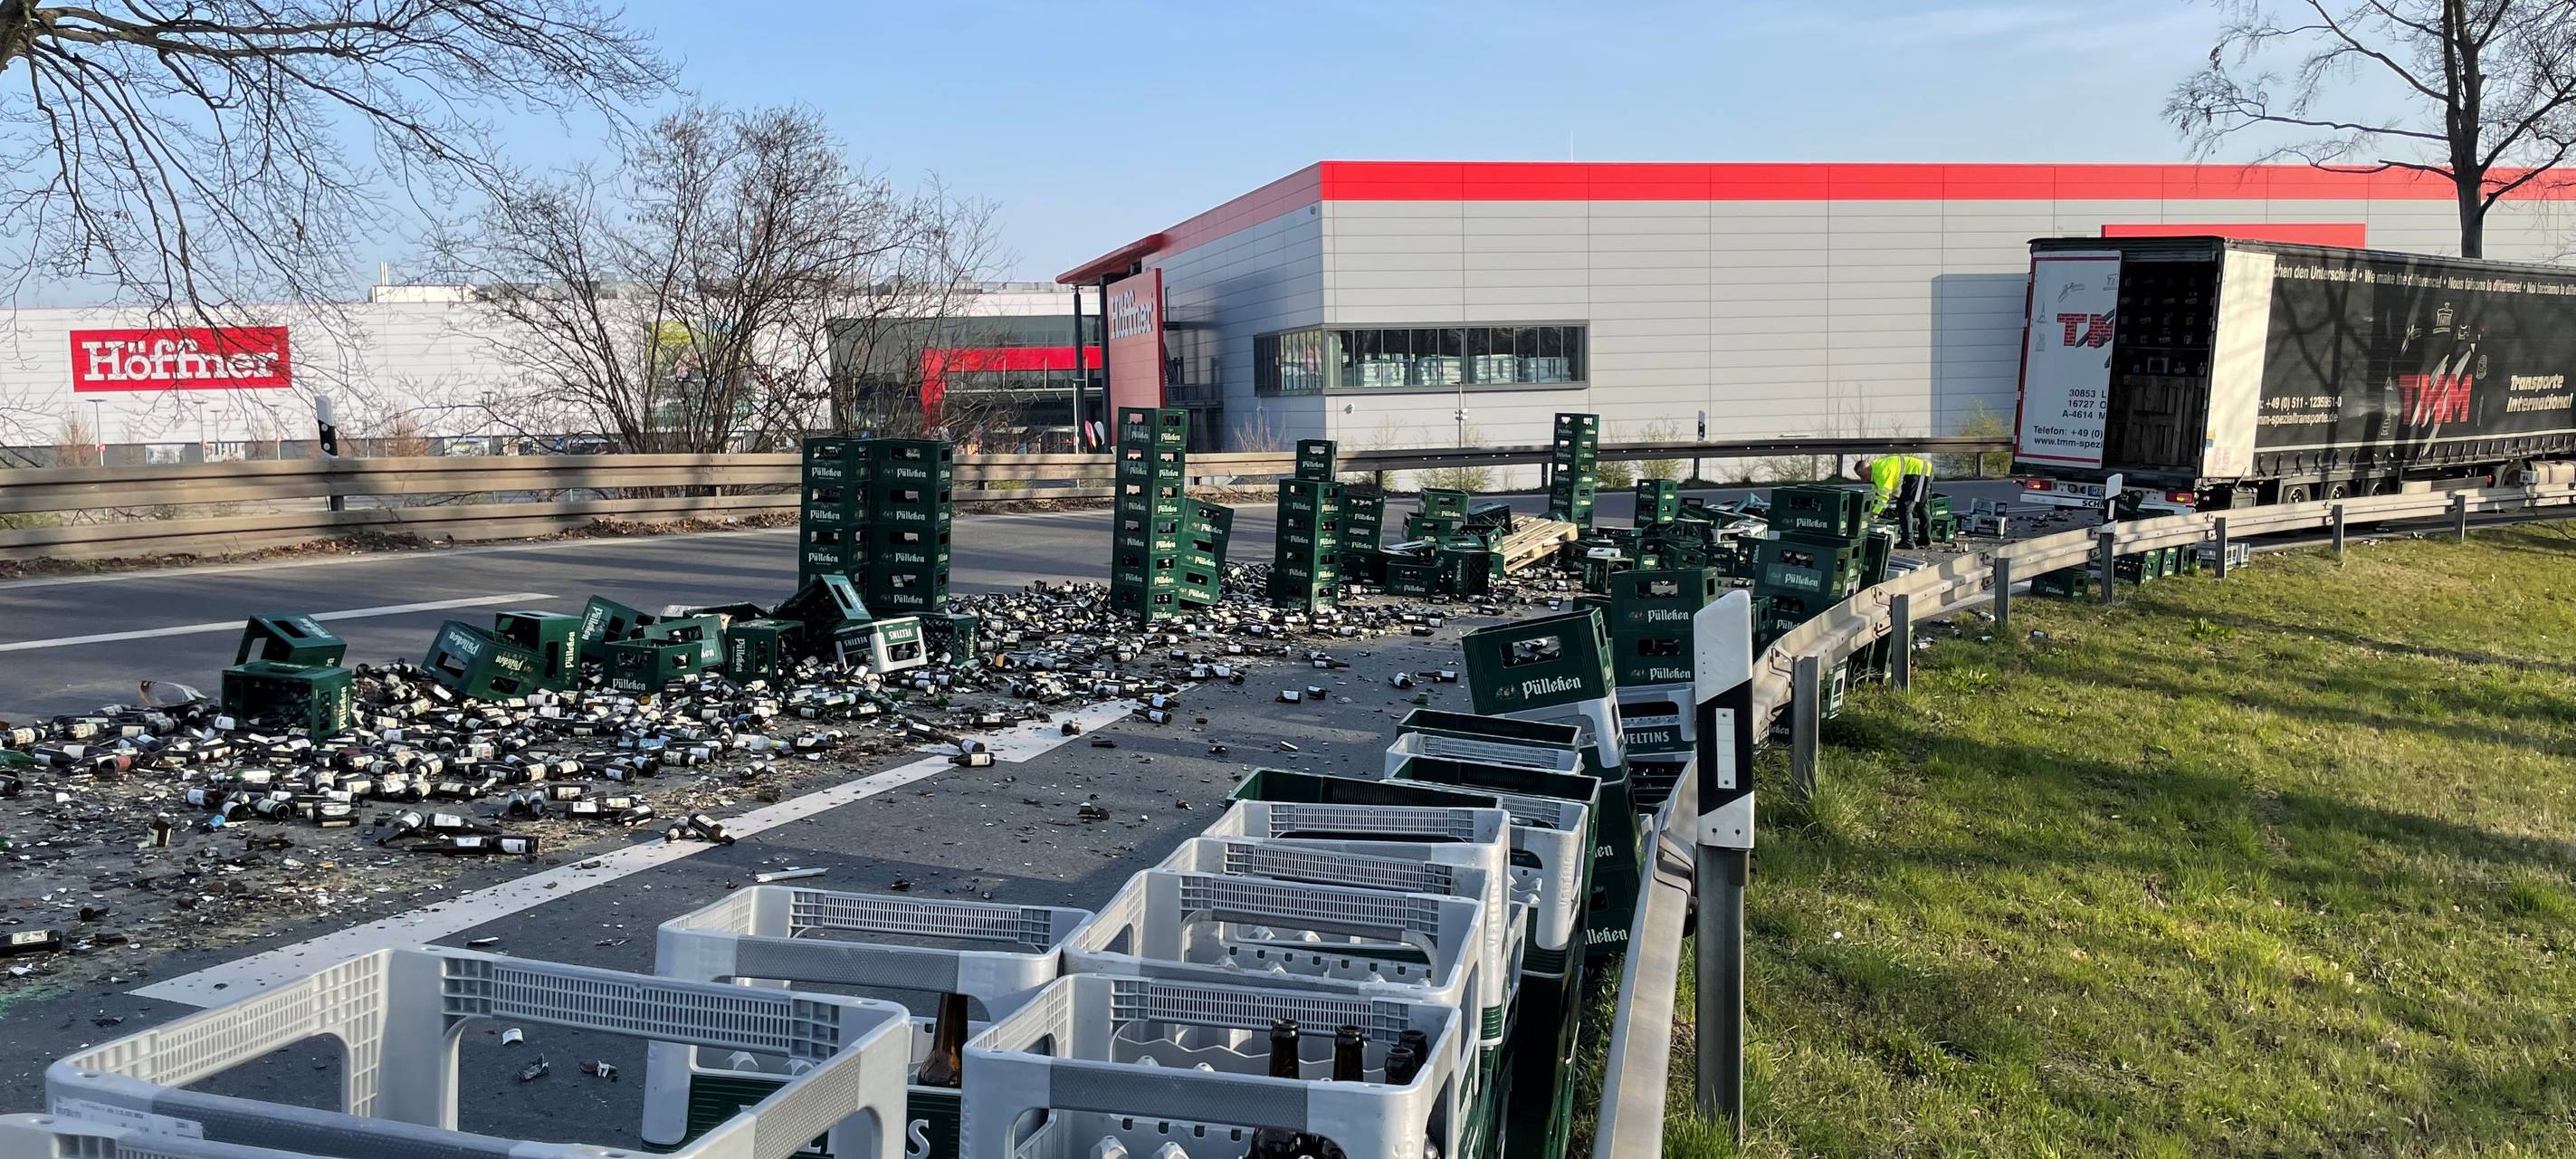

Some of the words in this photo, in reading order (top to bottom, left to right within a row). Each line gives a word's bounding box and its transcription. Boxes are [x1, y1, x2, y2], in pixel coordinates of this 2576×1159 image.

[2294, 265, 2308, 279] den
[2310, 265, 2357, 282] Unterschied!
[2365, 270, 2375, 283] We
[2376, 272, 2395, 285] make
[2396, 273, 2407, 285] the
[2448, 276, 2463, 289] Nous
[1111, 289, 1153, 340] Höffner
[82, 339, 278, 381] Höffner
[2510, 373, 2564, 392] Transporte
[2069, 389, 2096, 398] 30853
[2399, 374, 2473, 425] TMM
[2506, 392, 2573, 412] International
[2068, 400, 2094, 408] 16727
[2266, 398, 2280, 409] +49
[2280, 397, 2290, 411] (0)
[2291, 397, 2303, 408] 511
[2062, 410, 2092, 419] A-4614
[2034, 426, 2067, 435] Telefon:
[2091, 430, 2103, 439] (0)
